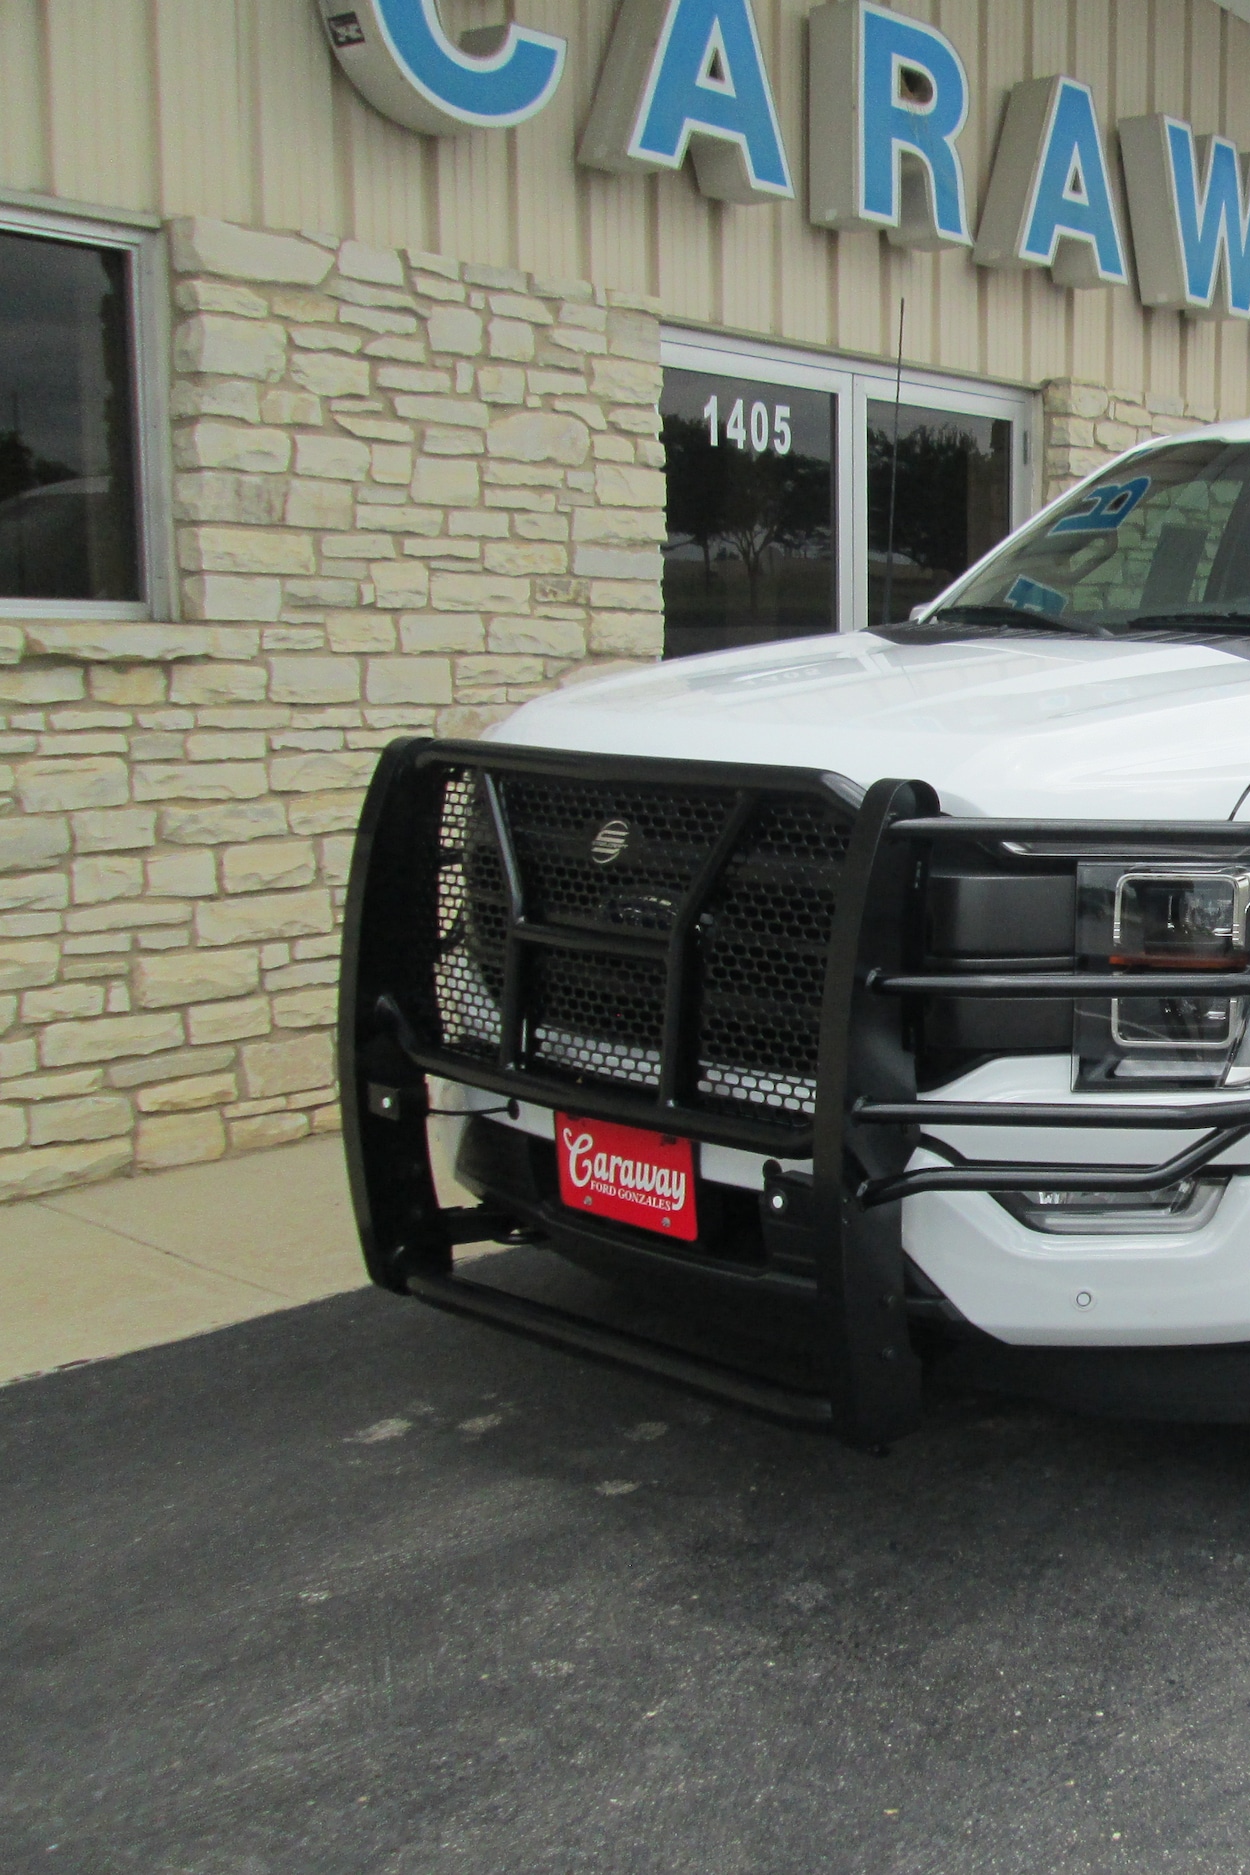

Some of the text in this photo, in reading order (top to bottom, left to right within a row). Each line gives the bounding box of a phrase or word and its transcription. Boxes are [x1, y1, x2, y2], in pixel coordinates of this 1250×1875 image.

[703, 394, 792, 455] 1405
[562, 1127, 686, 1211] Caraway
[590, 1180, 671, 1211] FORD GONZALES
